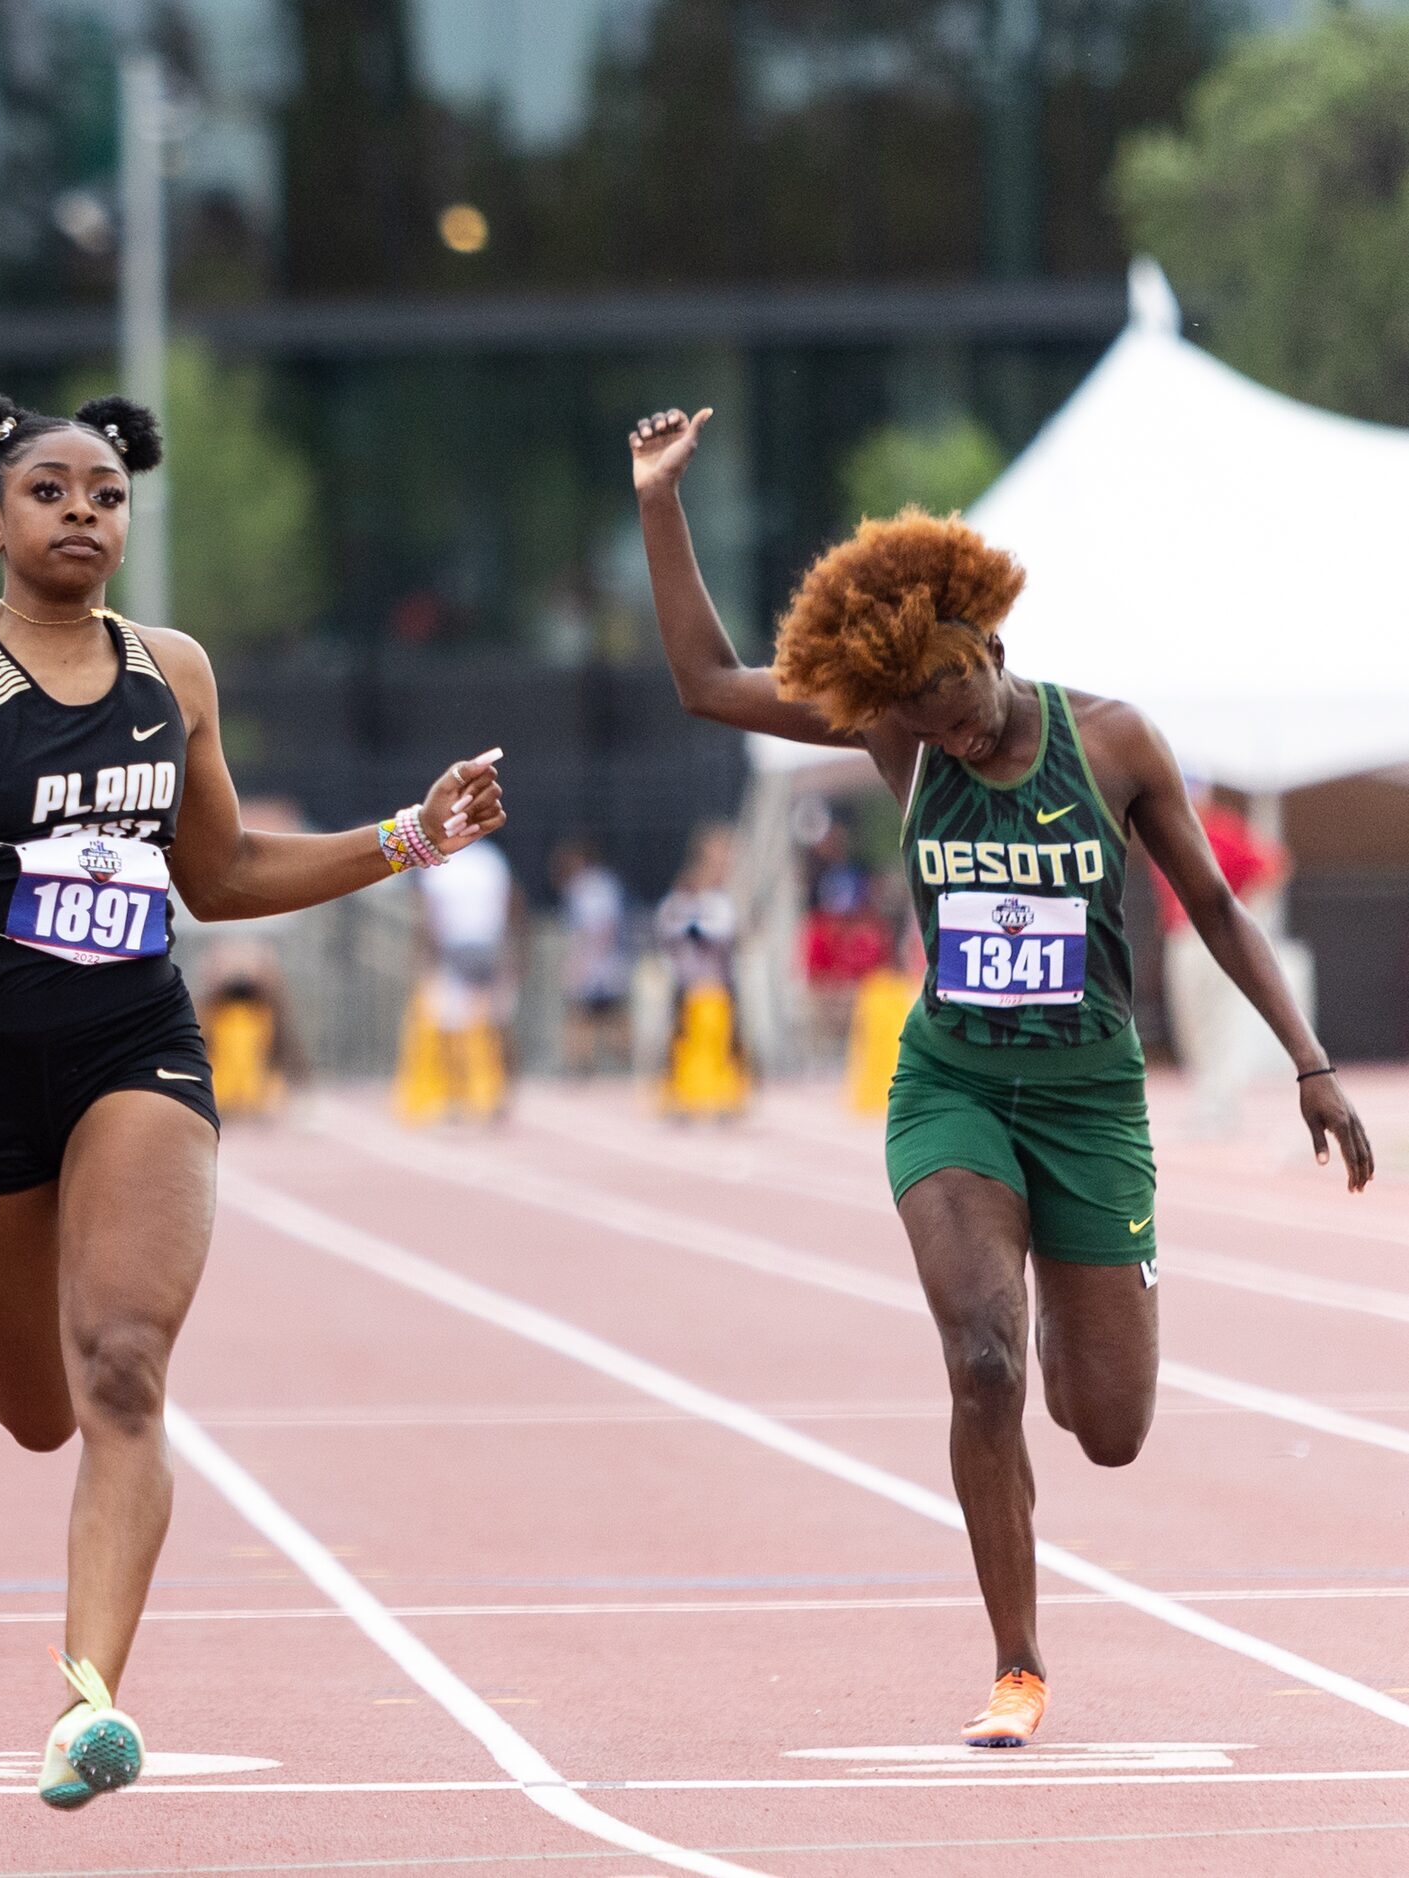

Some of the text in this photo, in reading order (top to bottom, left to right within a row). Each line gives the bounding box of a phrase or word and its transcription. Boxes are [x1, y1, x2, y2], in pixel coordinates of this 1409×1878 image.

[32, 762, 176, 824] PLANO
[78, 855, 122, 871] STATE
[917, 839, 1104, 887] DESOTO
[33, 881, 151, 950] 1897
[73, 952, 101, 965] 2022
[959, 936, 1065, 990] 1341
